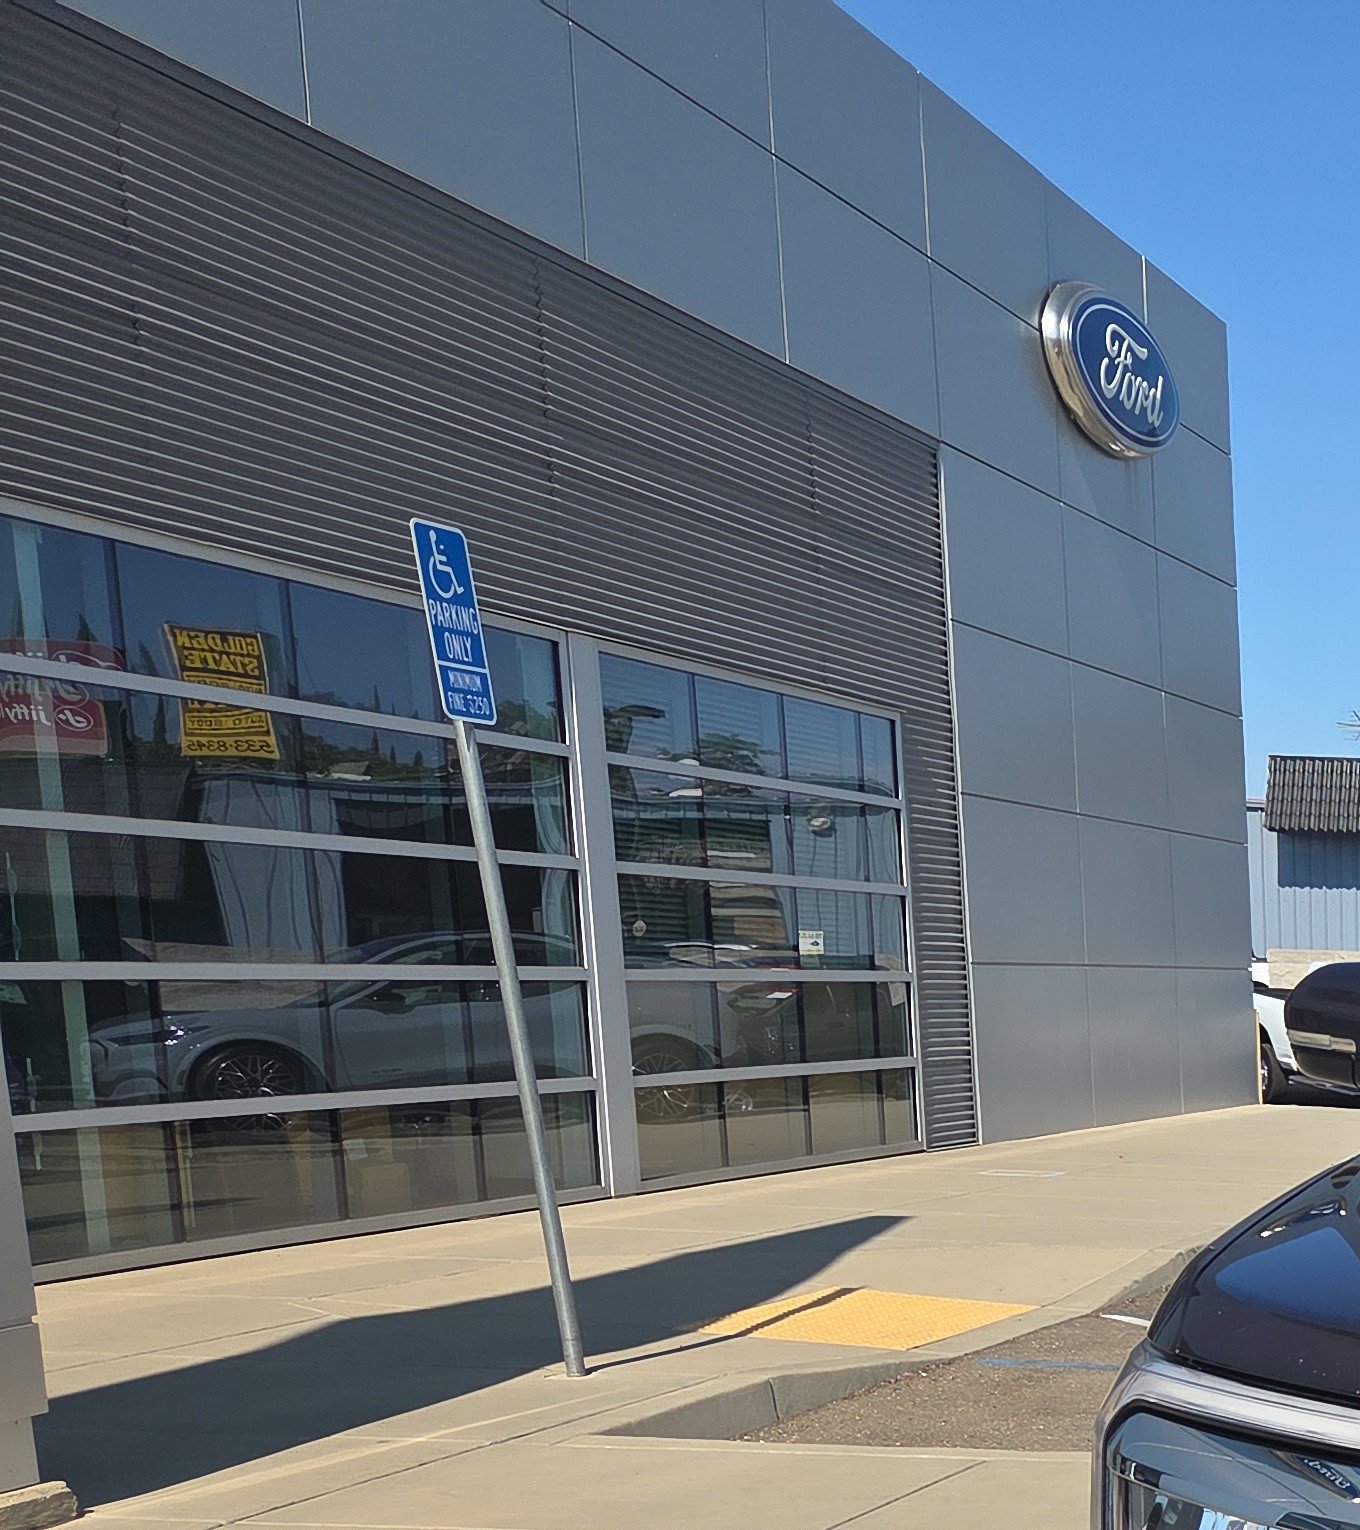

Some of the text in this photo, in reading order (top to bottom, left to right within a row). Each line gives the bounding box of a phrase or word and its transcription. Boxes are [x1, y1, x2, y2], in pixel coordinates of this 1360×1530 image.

[1100, 323, 1163, 427] Ford
[428, 599, 479, 635] PARKING
[443, 631, 473, 662] ONLY
